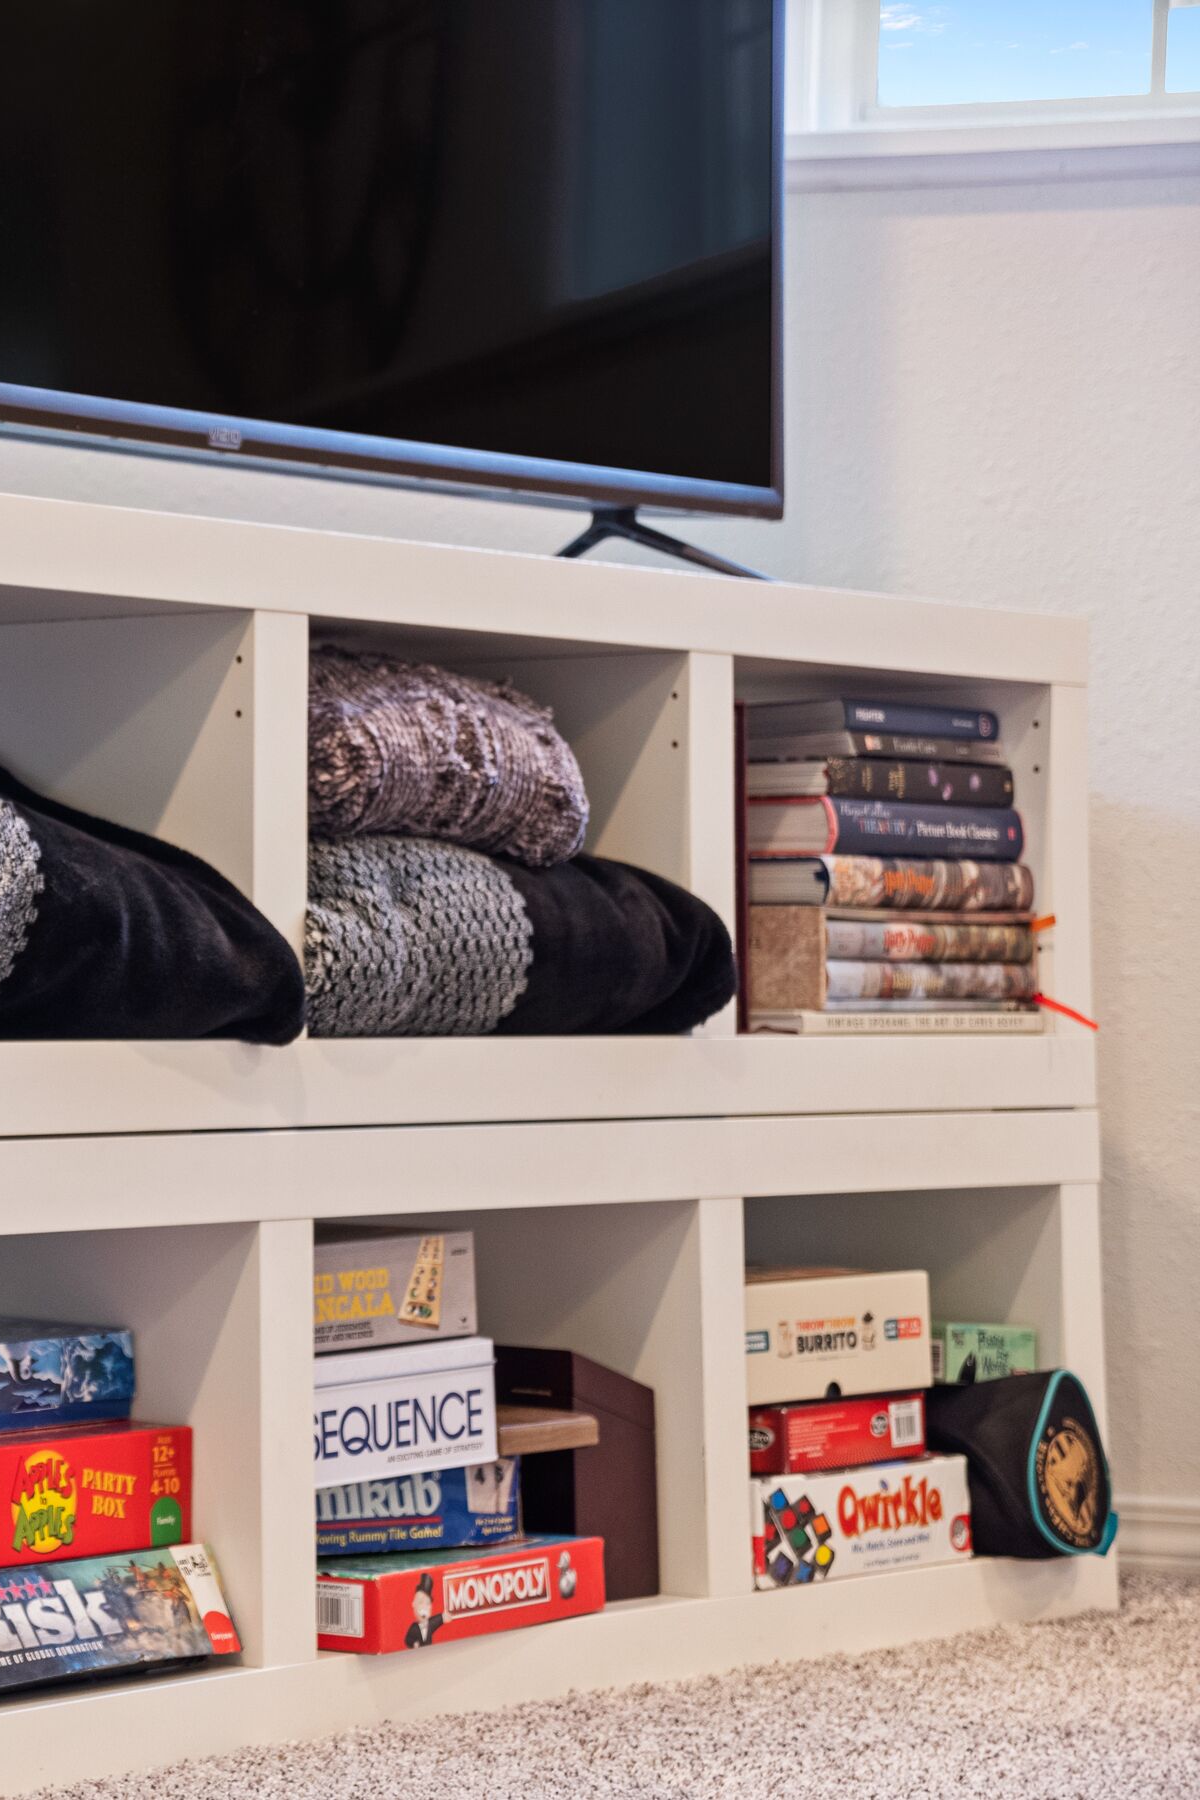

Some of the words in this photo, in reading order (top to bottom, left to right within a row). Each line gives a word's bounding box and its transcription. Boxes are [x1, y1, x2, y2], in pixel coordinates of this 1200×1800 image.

[337, 1267, 389, 1291] WOOD
[796, 1331, 858, 1353] BURRITO
[152, 1446, 175, 1463] 12+
[81, 1468, 137, 1496] PARTY
[150, 1478, 181, 1495] 4-10
[91, 1495, 126, 1519] BOX
[836, 1473, 944, 1540] Qwirkle
[348, 1530, 387, 1546] Rummy
[388, 1528, 407, 1541] Tile
[409, 1525, 444, 1540] Game!
[447, 1566, 546, 1612] MONOPOLY
[14, 1653, 25, 1665] OF
